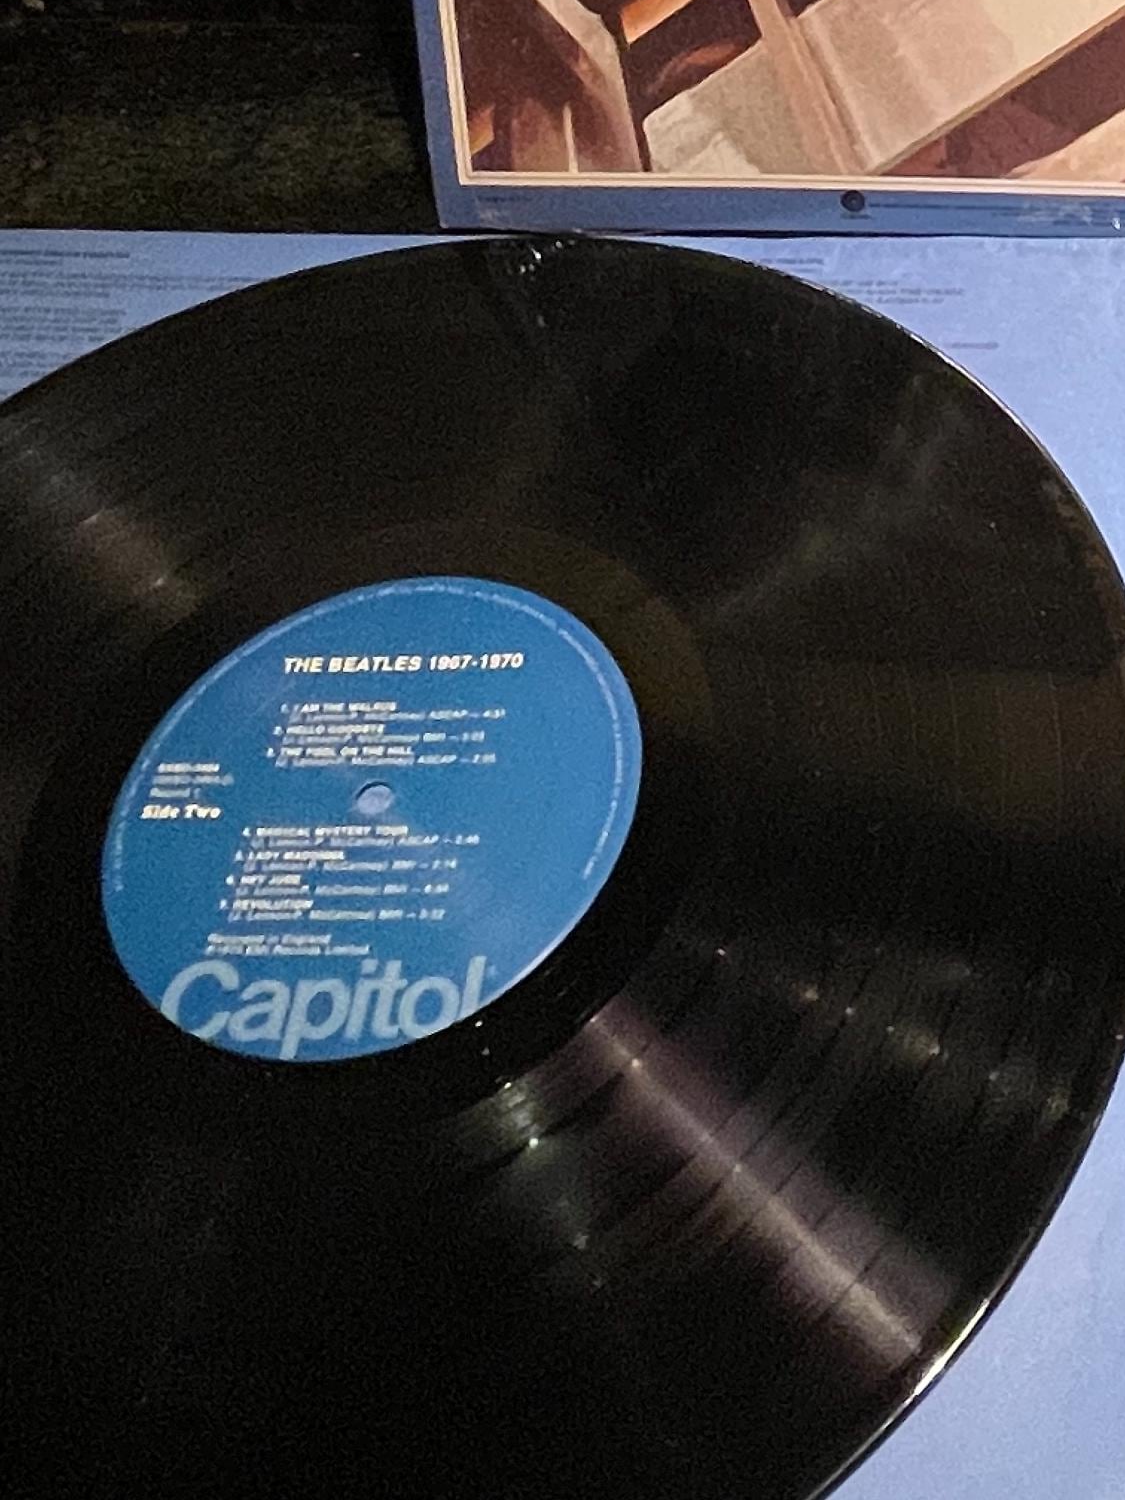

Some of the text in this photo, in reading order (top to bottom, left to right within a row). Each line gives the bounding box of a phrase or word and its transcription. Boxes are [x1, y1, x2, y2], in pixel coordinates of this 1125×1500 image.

[284, 652, 523, 673] THE BEATLES 1967-1970
[141, 803, 221, 819] Side Two
[160, 955, 487, 1061] Capitol
